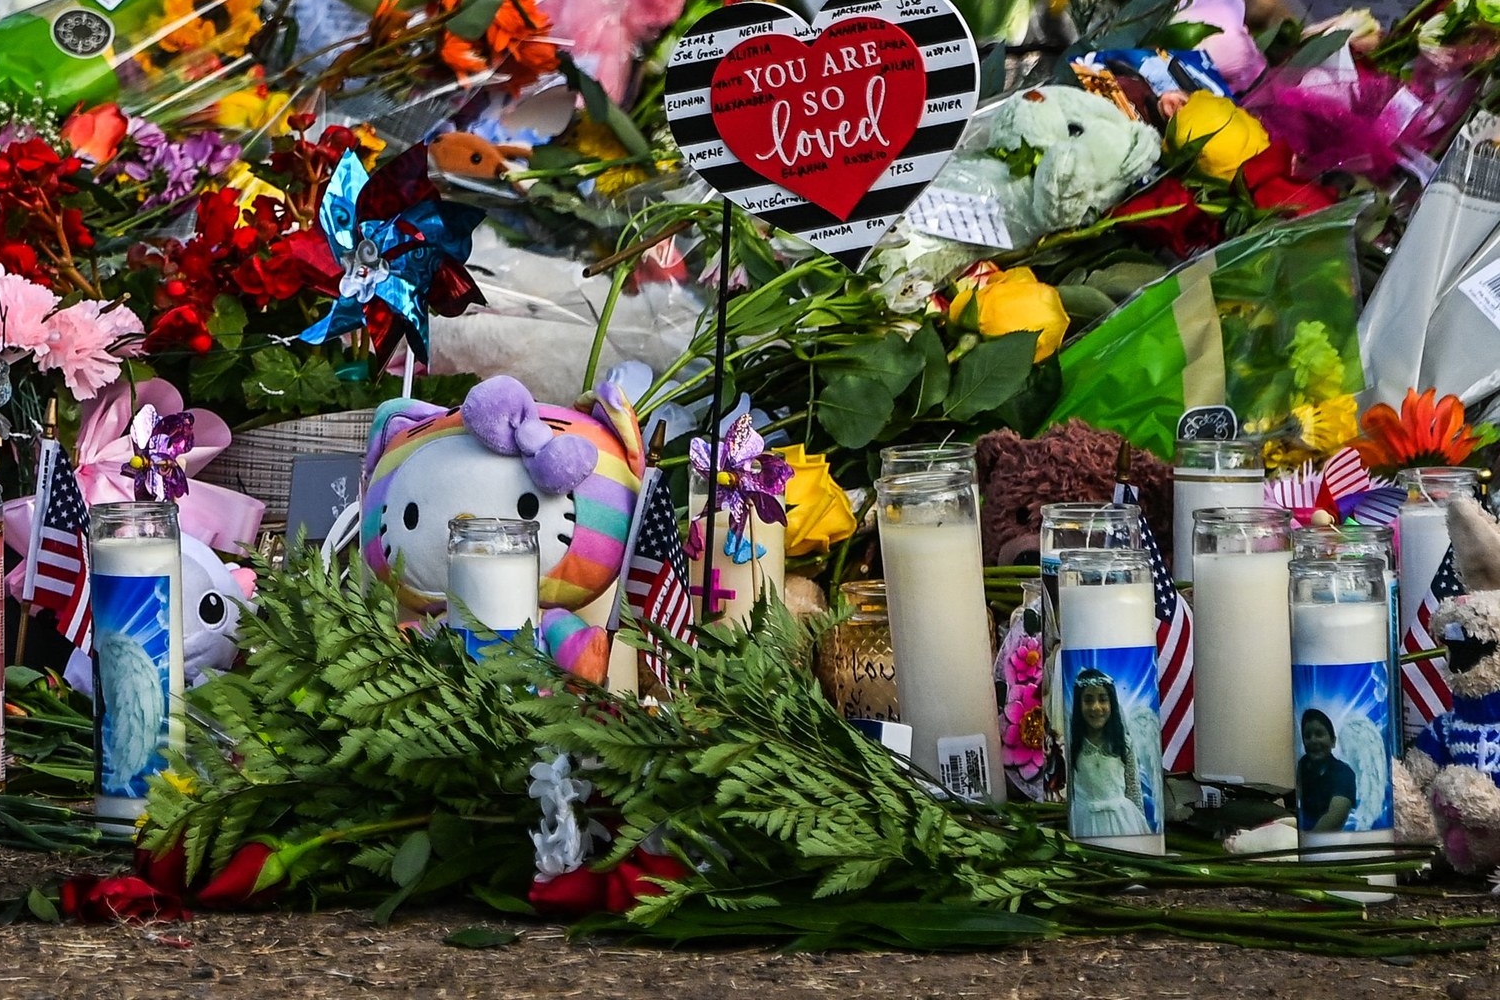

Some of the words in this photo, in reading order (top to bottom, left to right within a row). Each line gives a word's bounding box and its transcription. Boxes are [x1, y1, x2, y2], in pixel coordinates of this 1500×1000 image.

[739, 21, 774, 37] NEVAEH
[744, 56, 807, 92] YOU
[821, 41, 882, 77] ARE
[803, 86, 845, 116] SO
[927, 99, 962, 113] XAVIER
[756, 76, 890, 166] loved
[890, 163, 914, 177] TESS
[810, 225, 853, 241] MIRANDA
[866, 218, 885, 230] EVA
